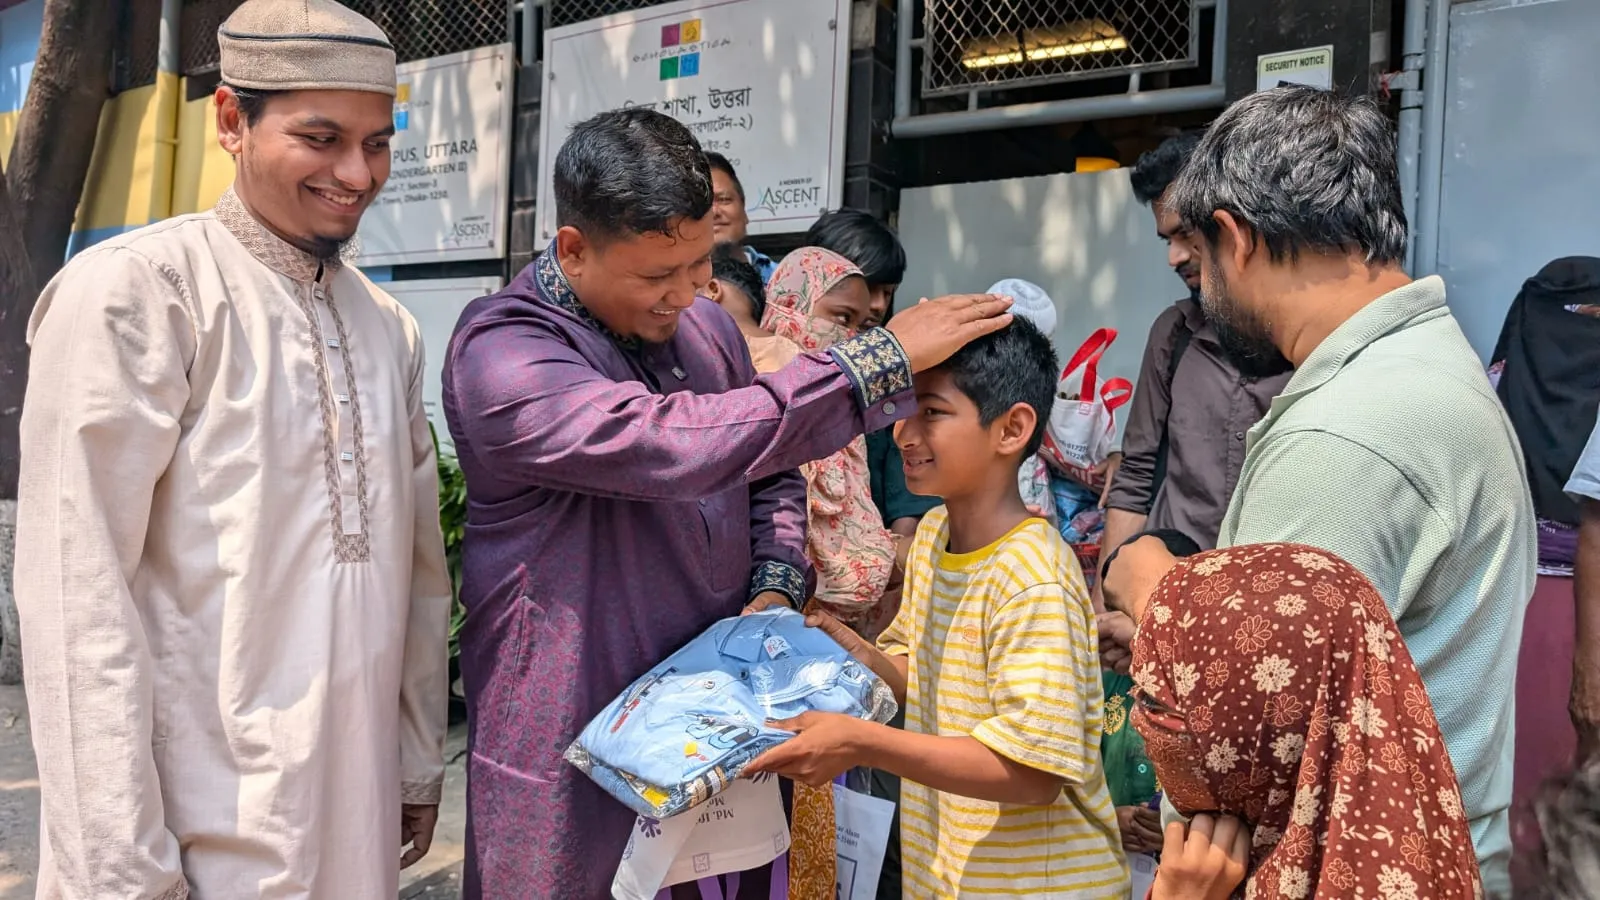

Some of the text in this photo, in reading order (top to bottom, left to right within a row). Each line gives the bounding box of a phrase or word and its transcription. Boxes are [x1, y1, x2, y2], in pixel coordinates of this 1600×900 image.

[1265, 55, 1326, 72] SECURITY NOTICE
[708, 87, 752, 109] উত্তরা
[393, 139, 478, 163] PUS, UTTARA
[761, 186, 821, 206] ASCENT
[452, 222, 491, 238] ASCENT
